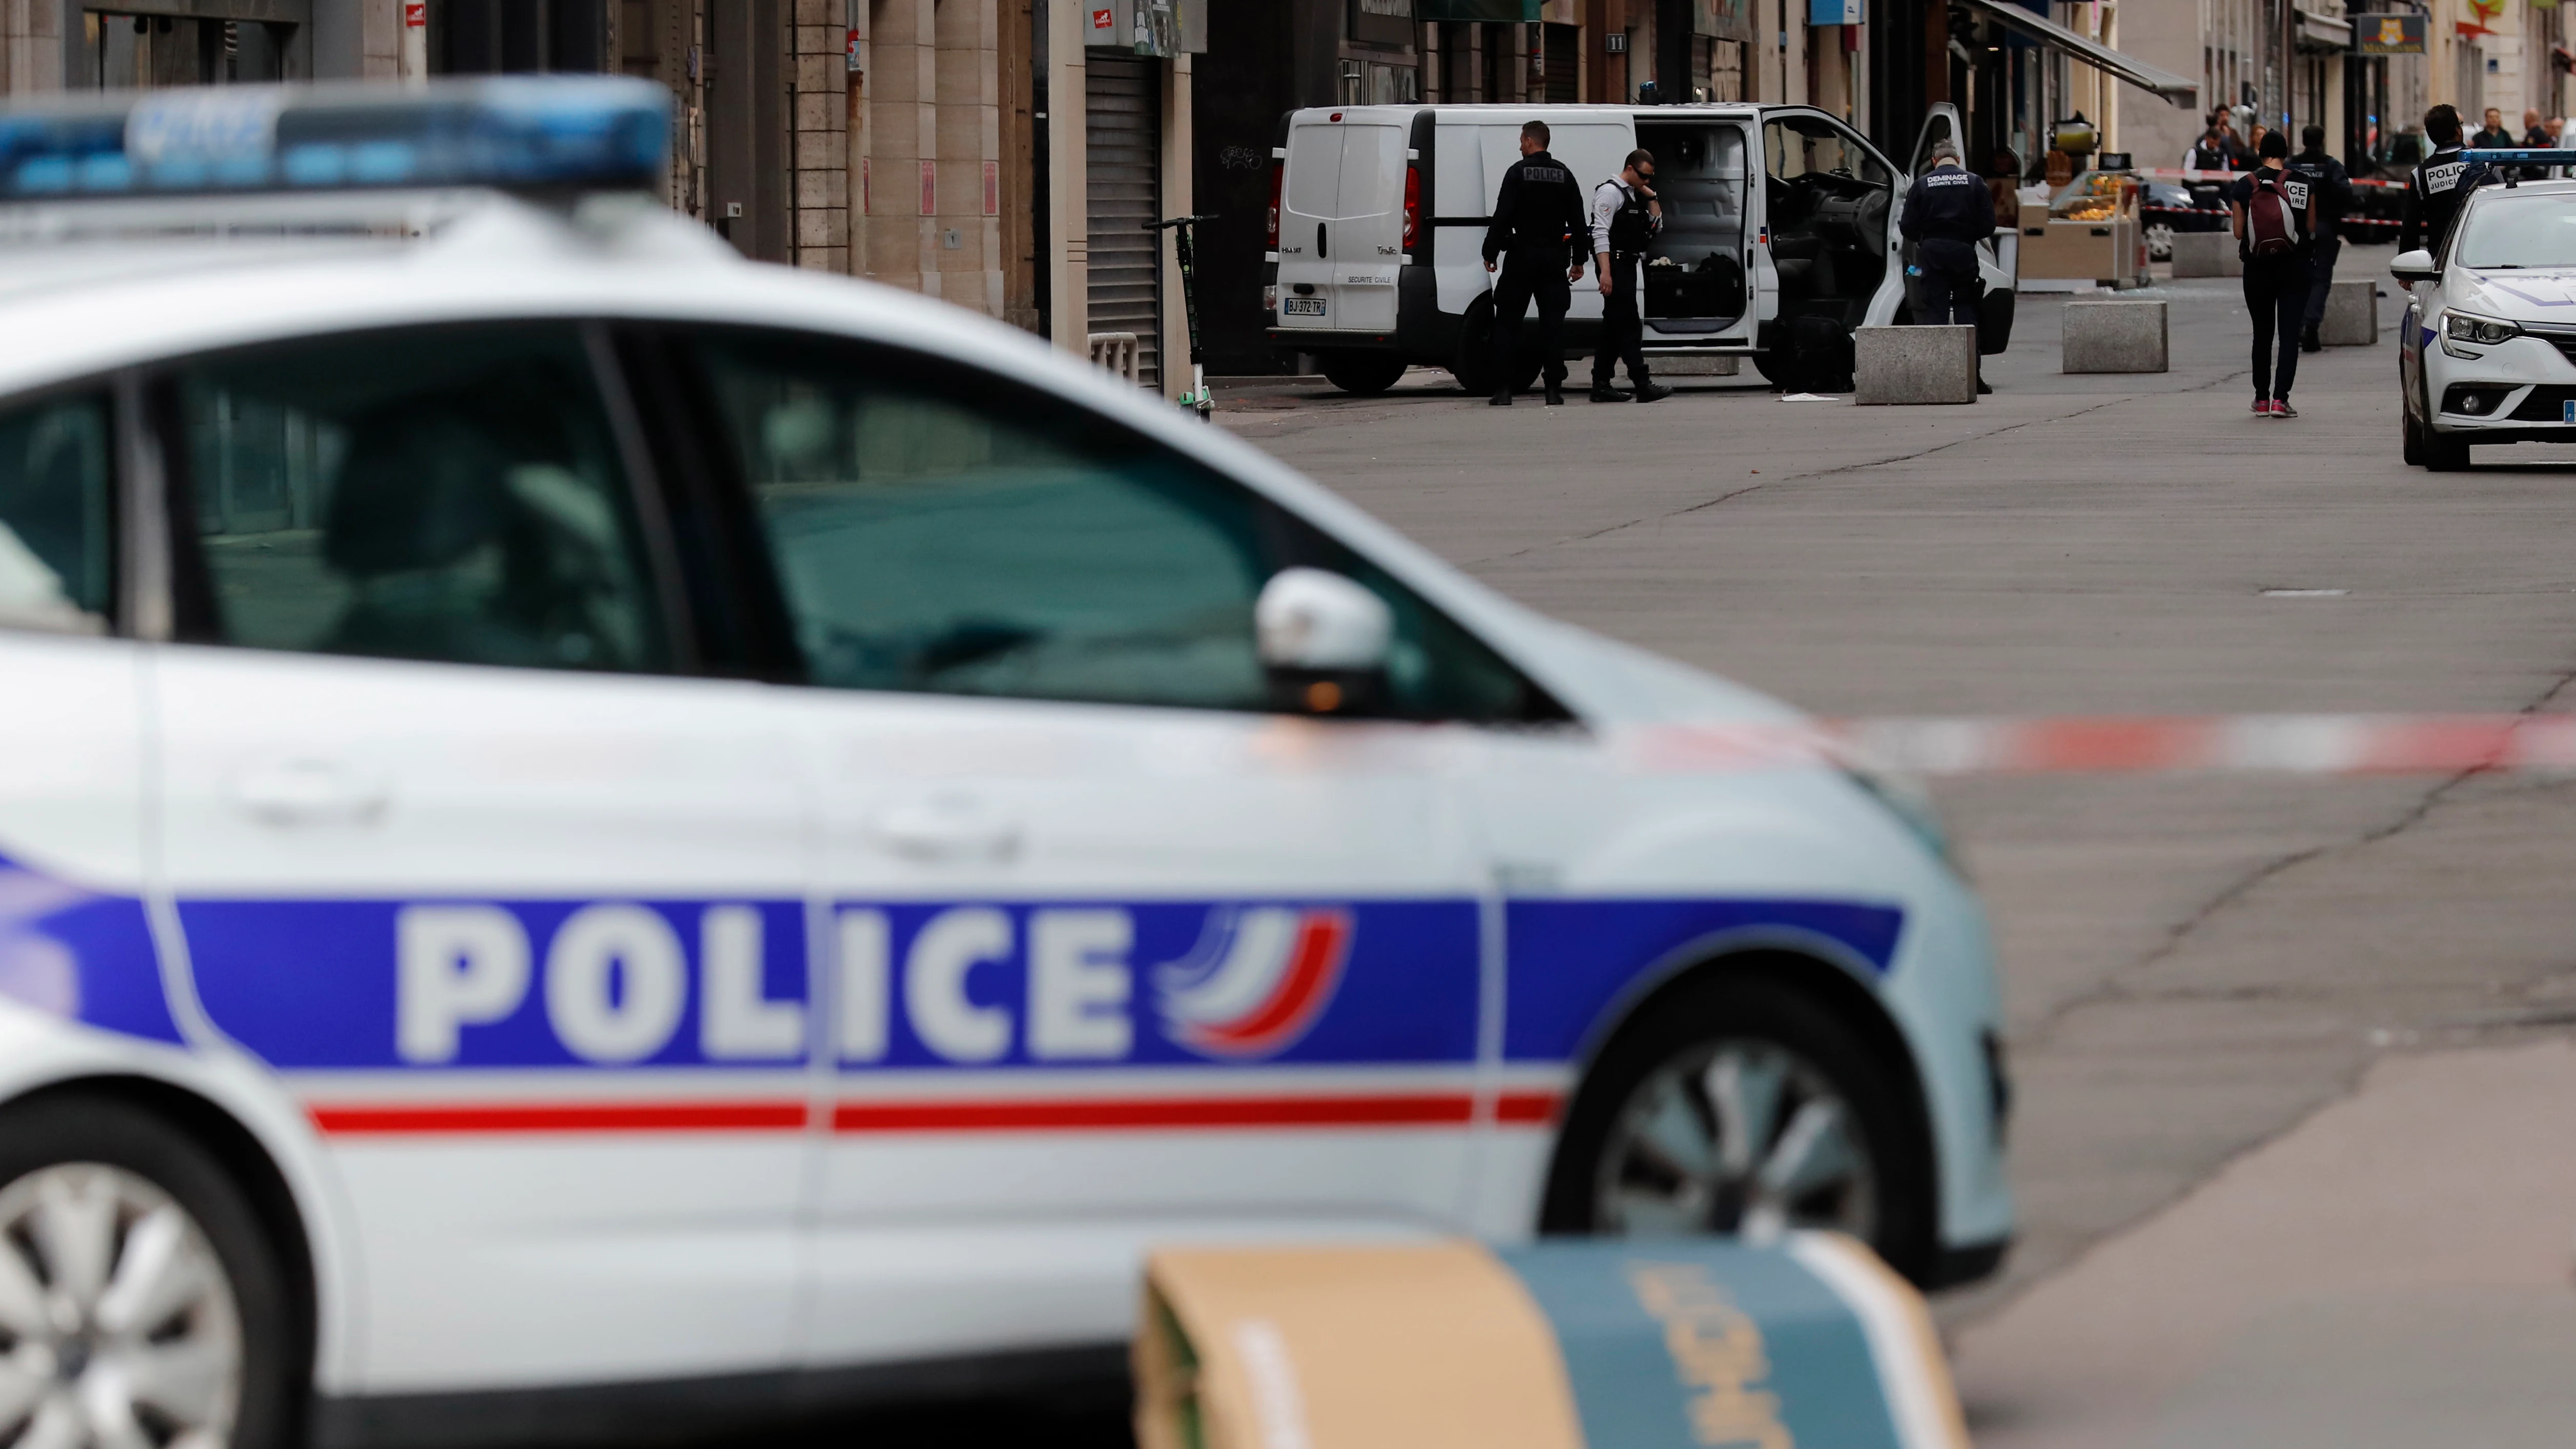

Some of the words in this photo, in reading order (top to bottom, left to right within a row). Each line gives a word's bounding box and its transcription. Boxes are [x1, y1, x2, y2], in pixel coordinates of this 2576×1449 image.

[1611, 36, 1623, 50] 11
[1526, 168, 1563, 181] POLICE
[1927, 174, 1968, 183] DEMINAGE
[2430, 178, 2456, 190] JUDICI
[2286, 185, 2306, 196] ICE
[395, 903, 1134, 1065] POLICE
